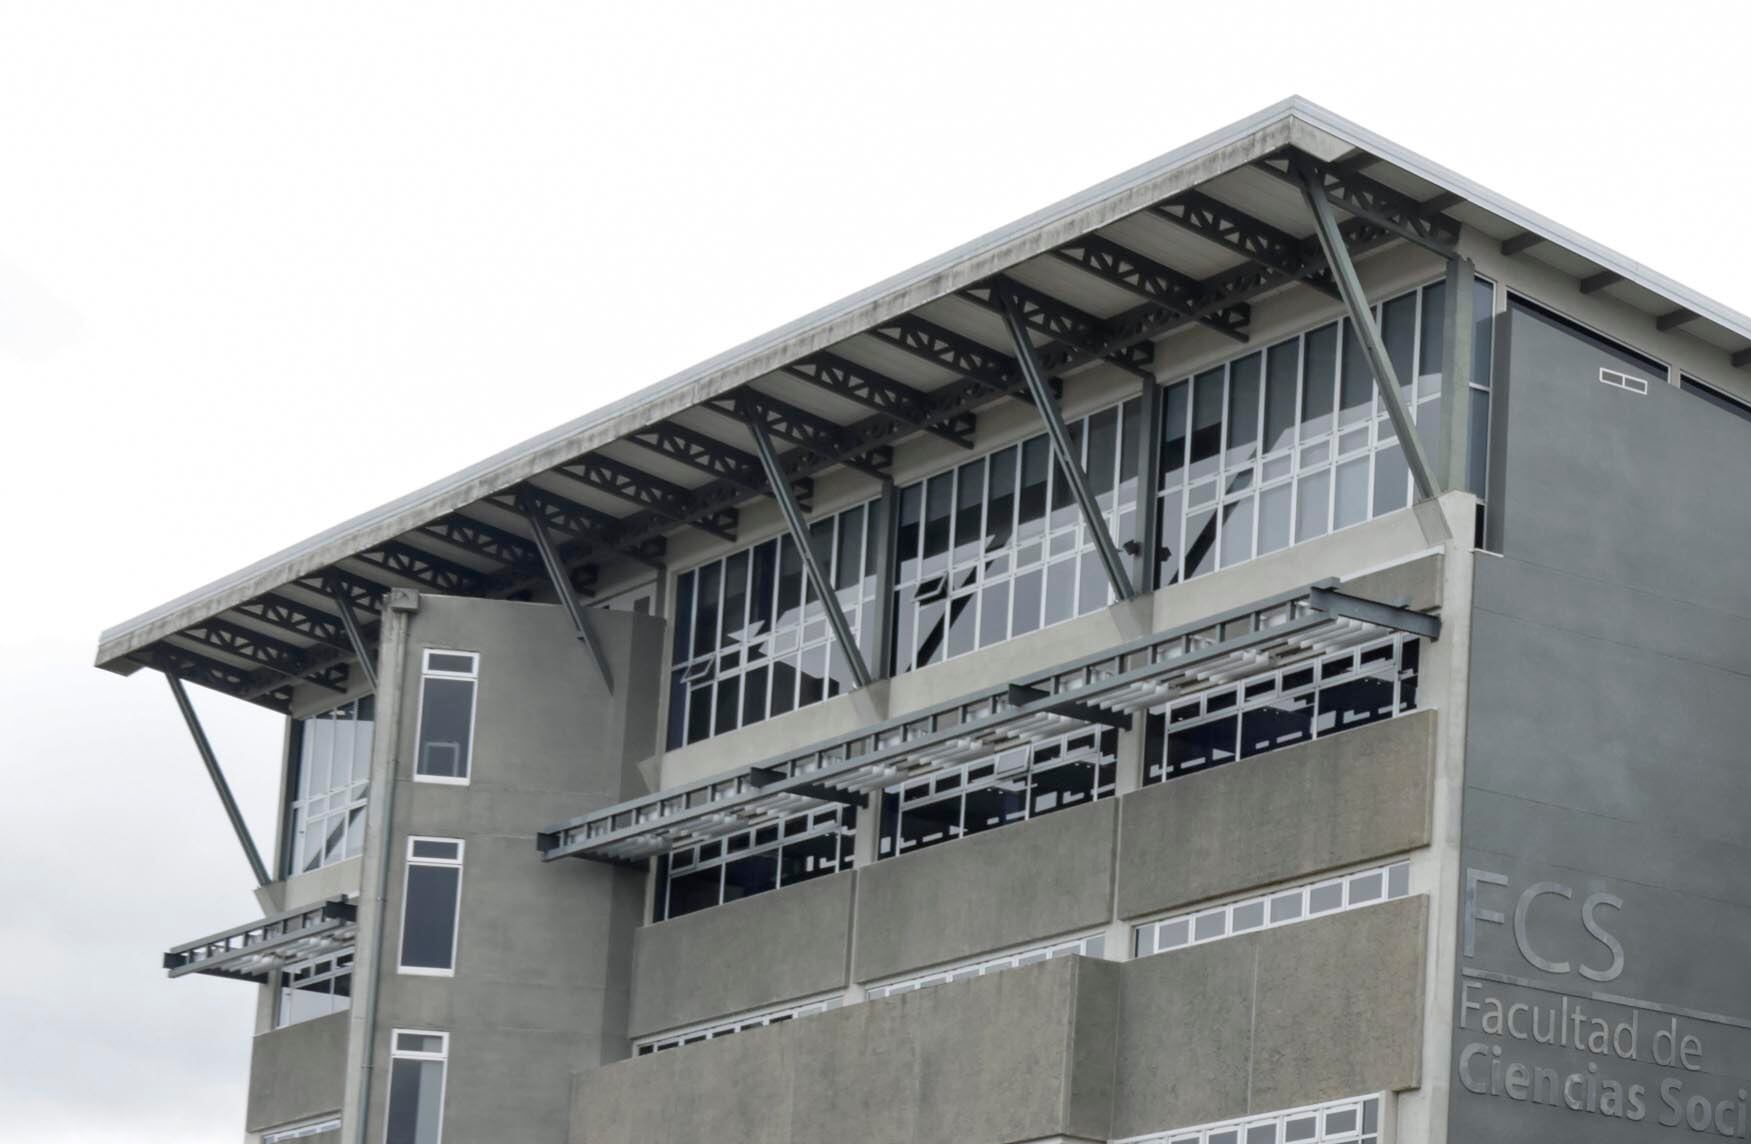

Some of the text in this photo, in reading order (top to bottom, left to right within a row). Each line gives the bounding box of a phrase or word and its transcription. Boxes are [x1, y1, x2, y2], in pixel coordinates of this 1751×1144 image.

[1463, 867, 1625, 982] FCS
[1457, 981, 1703, 1071] Facultad de
[1458, 1042, 1646, 1121] Ciencias
